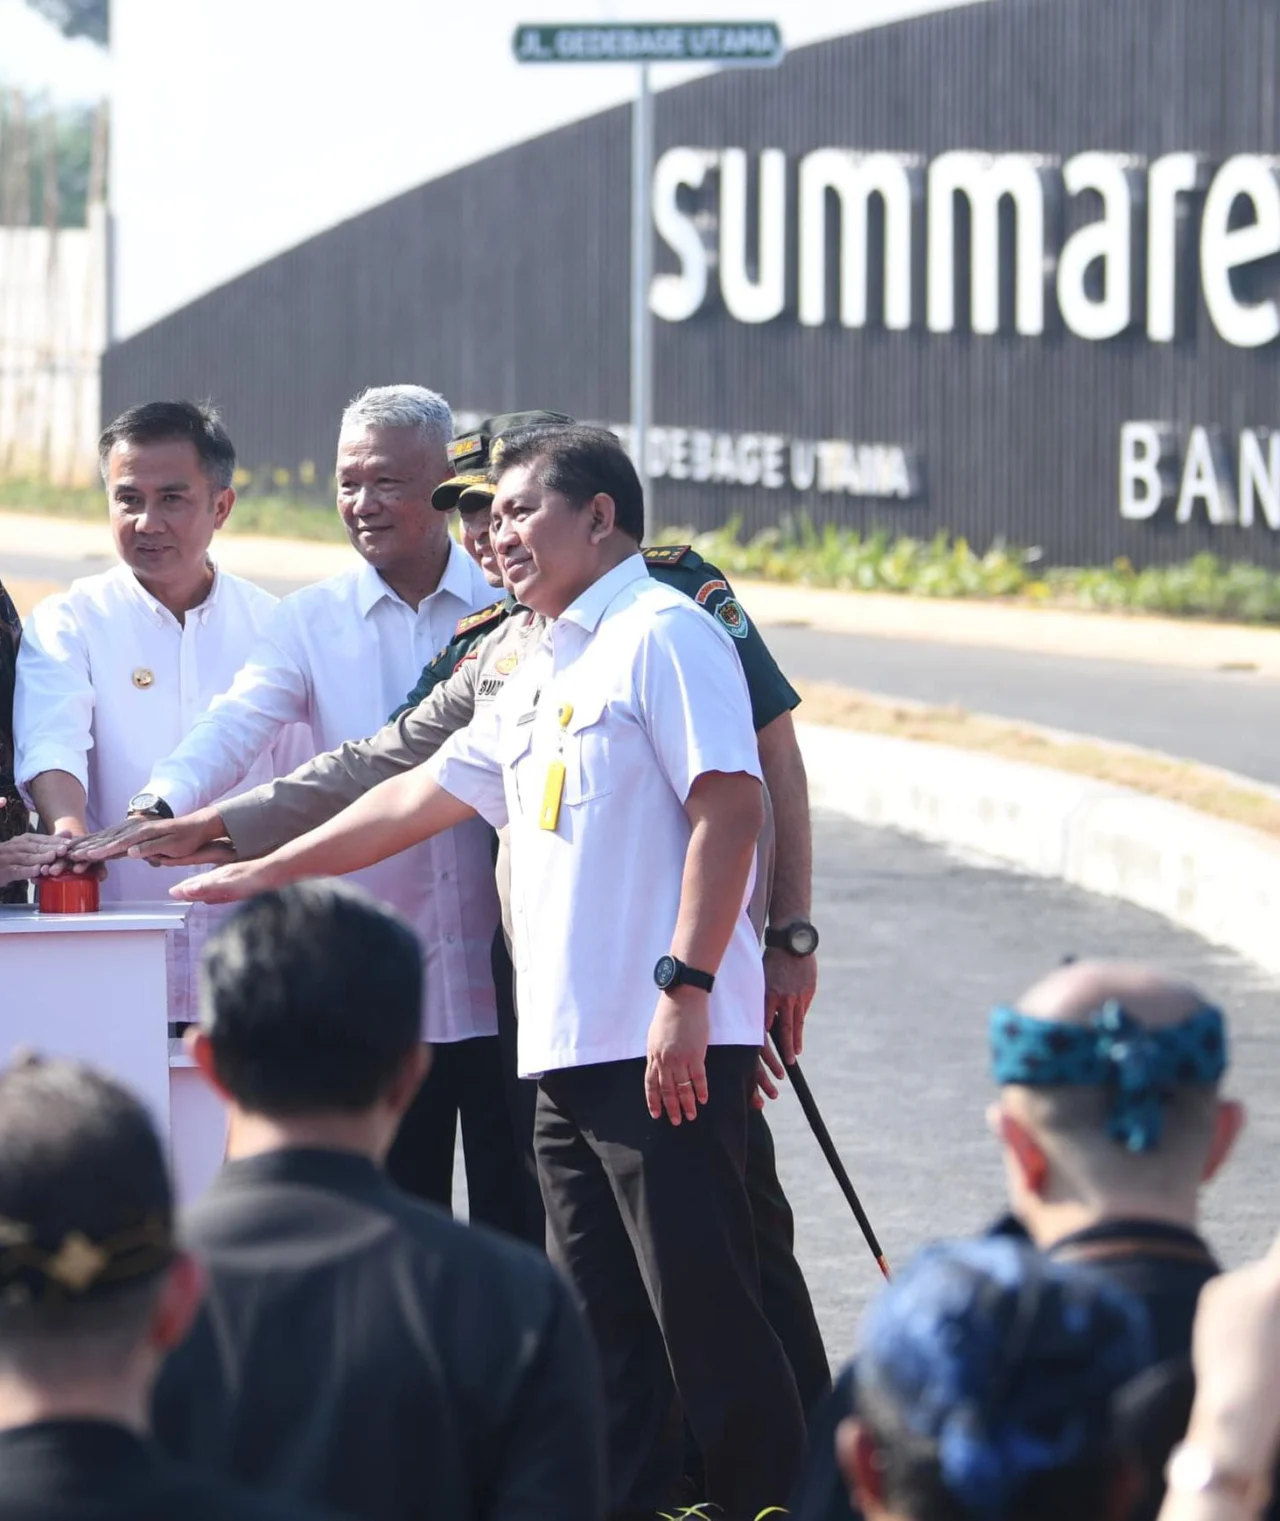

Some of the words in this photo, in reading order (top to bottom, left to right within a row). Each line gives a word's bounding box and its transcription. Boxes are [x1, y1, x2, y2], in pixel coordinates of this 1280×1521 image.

[554, 28, 686, 58] GEDEBAGE
[688, 27, 776, 56] UTAMA
[648, 146, 1280, 349] summare
